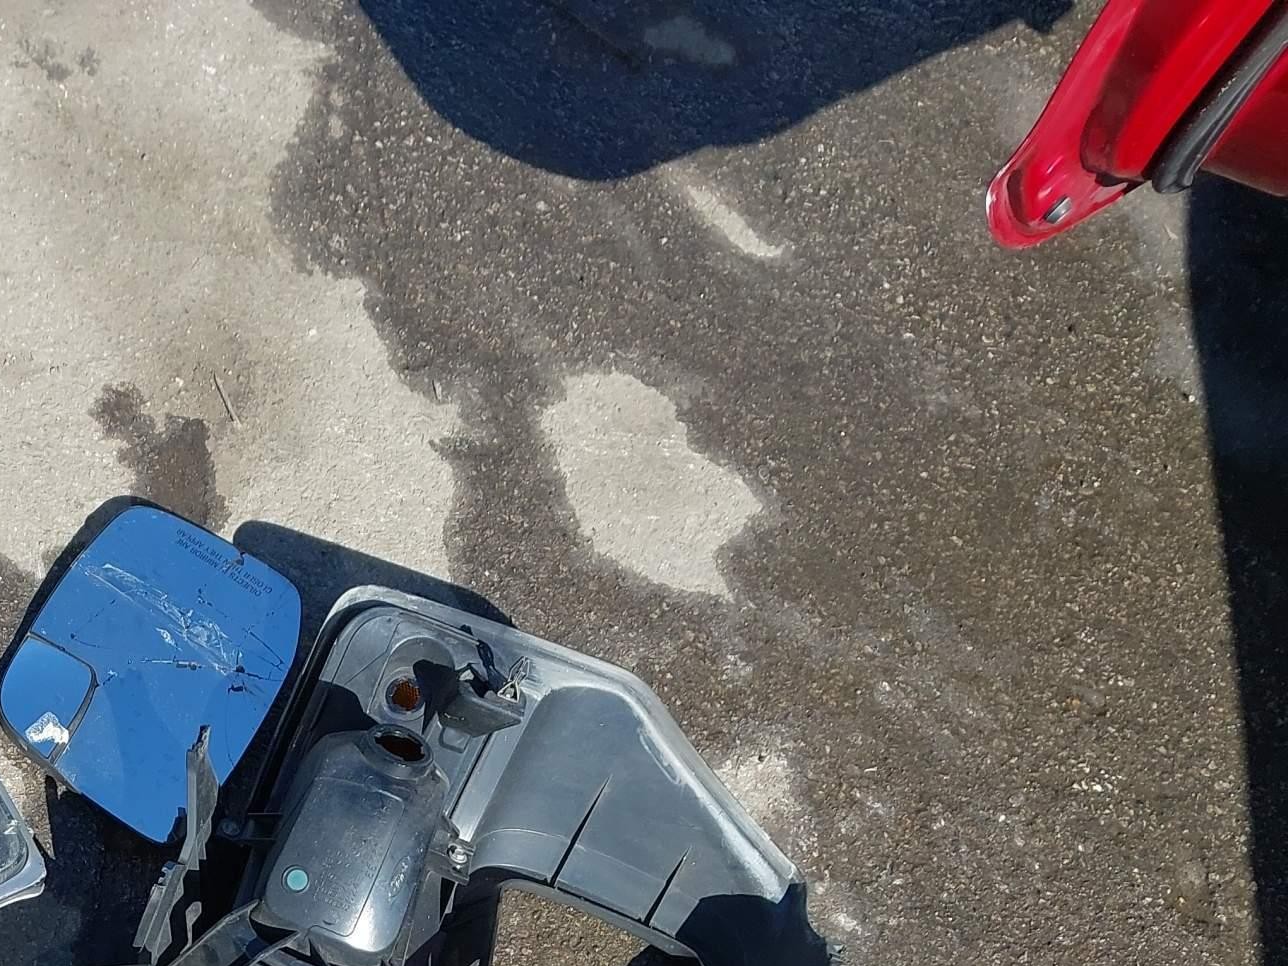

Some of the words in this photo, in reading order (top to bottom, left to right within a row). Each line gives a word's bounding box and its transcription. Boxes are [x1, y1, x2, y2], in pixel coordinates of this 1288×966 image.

[176, 528, 203, 548] APPEAR
[176, 538, 190, 550] ARE
[189, 548, 219, 569] MIRROR
[205, 546, 223, 561] THEY
[229, 573, 262, 597] OBJECTS
[243, 572, 273, 594] CLOSER
